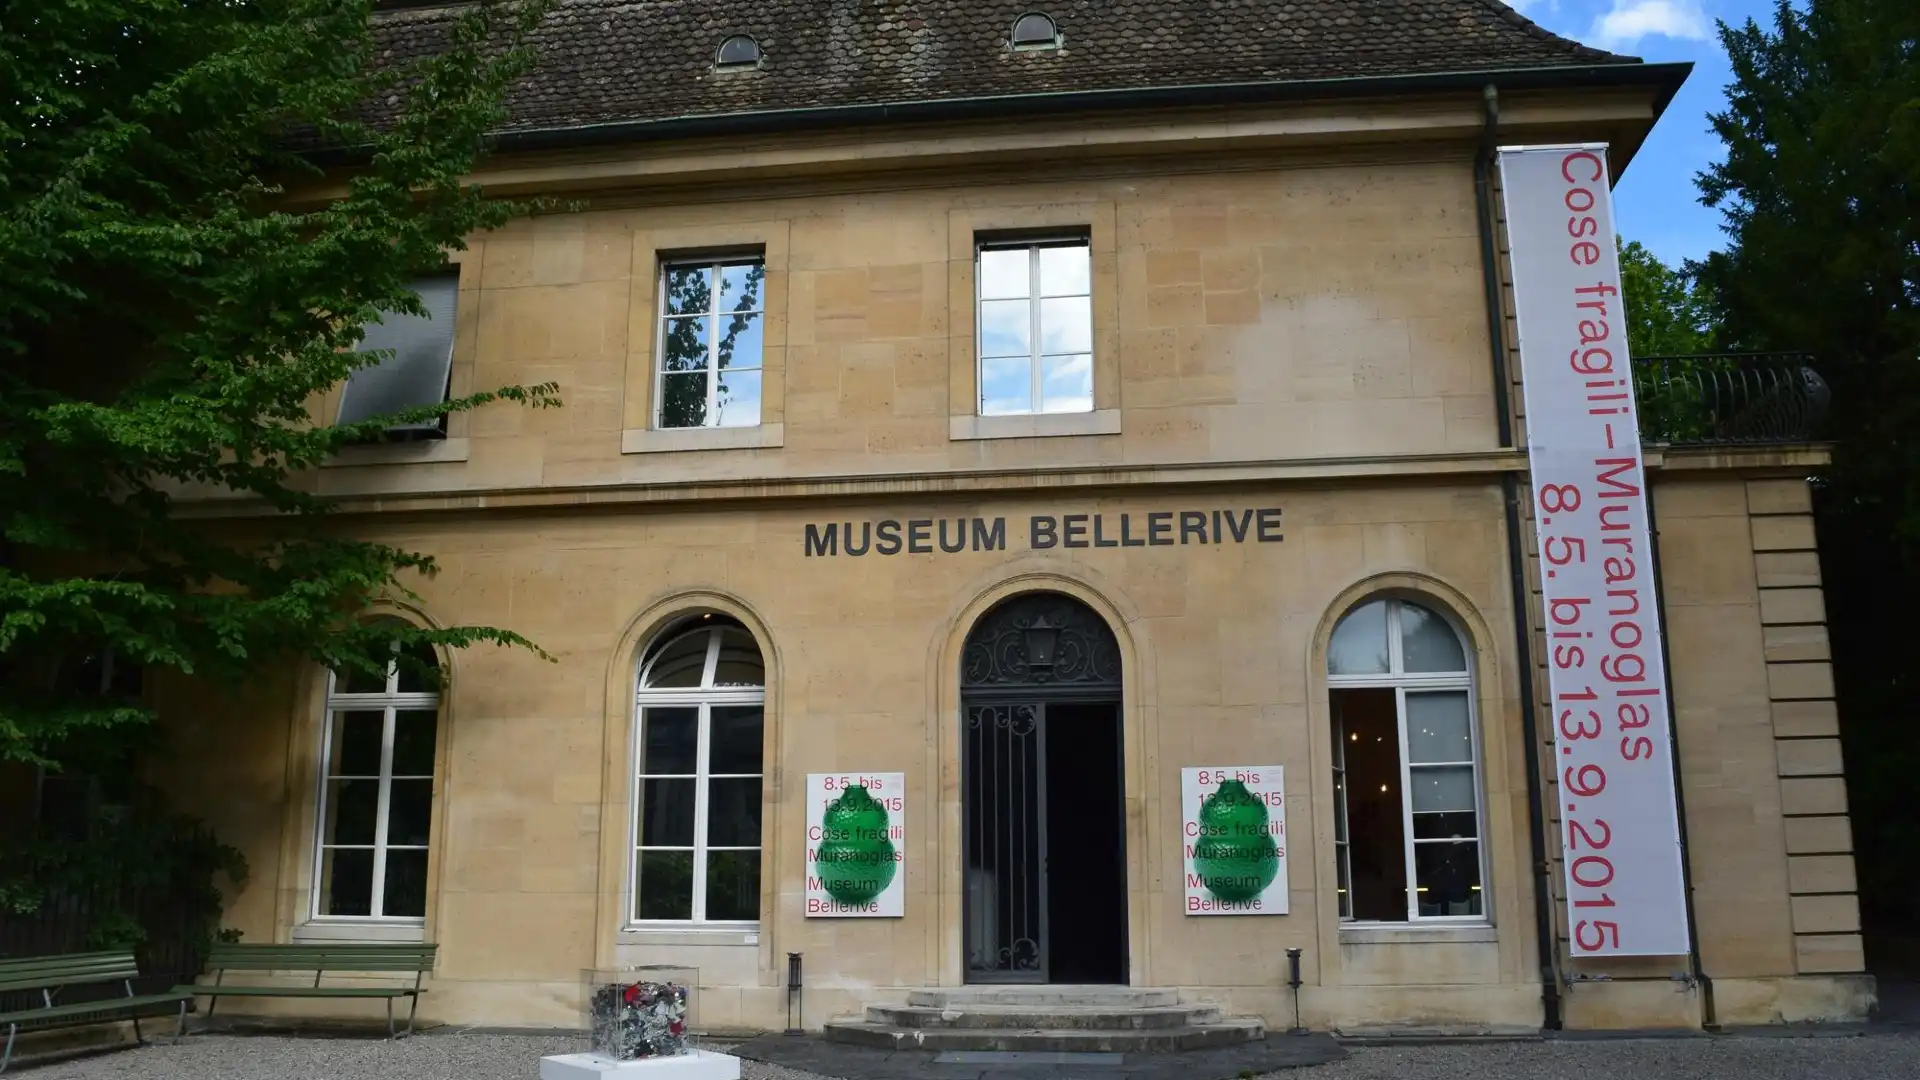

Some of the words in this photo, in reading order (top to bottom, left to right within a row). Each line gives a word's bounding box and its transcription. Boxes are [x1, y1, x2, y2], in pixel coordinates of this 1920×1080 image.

[1561, 152, 1603, 266] Cose
[804, 517, 1006, 557] MUSEUM
[1030, 508, 1284, 549] BELLERIVE
[1540, 483, 1587, 578] 8.5.
[1550, 598, 1593, 669] bis
[859, 776, 883, 790] bis
[1235, 769, 1260, 784] bis
[1558, 686, 1621, 952] 13.9.2015
[809, 826, 850, 841] Cose
[855, 826, 903, 844] fragili
[1185, 821, 1228, 836] Cose
[1235, 820, 1285, 837] fragili
[809, 848, 903, 865] Muranoglas
[1186, 844, 1285, 862] Muranoglas
[808, 876, 879, 891] Museum
[1187, 872, 1261, 888] Museum
[808, 898, 878, 913] Bellerive
[1188, 896, 1262, 911] Bellerive
